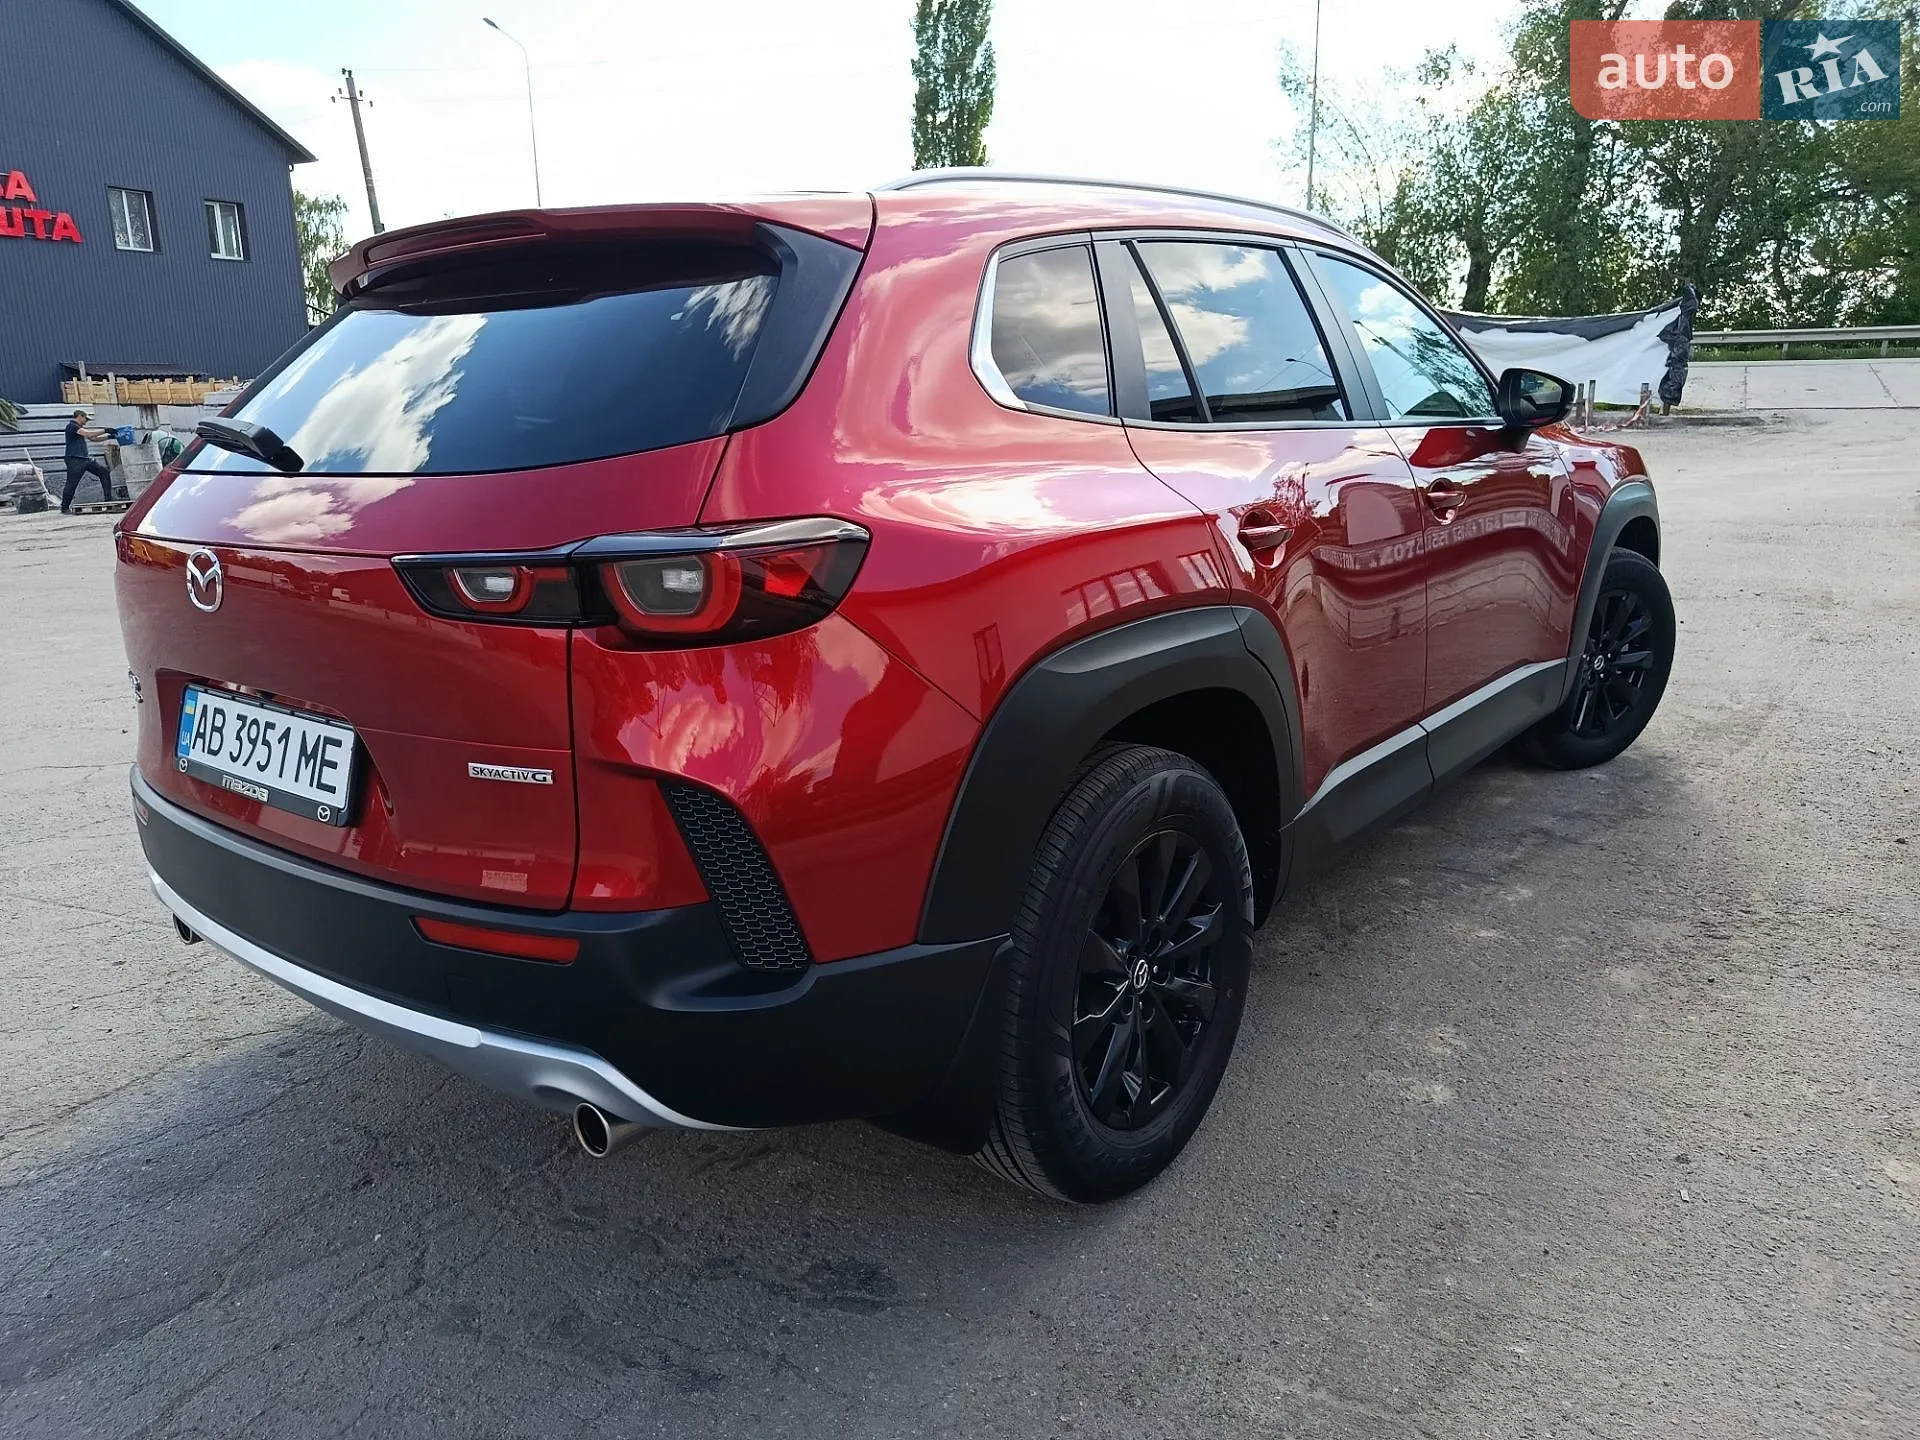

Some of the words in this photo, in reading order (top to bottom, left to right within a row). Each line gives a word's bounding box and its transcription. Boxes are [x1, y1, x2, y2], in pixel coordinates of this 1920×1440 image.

[0, 170, 37, 203] А
[192, 704, 226, 756] AB
[229, 713, 292, 778] 3951
[294, 730, 342, 794] ME
